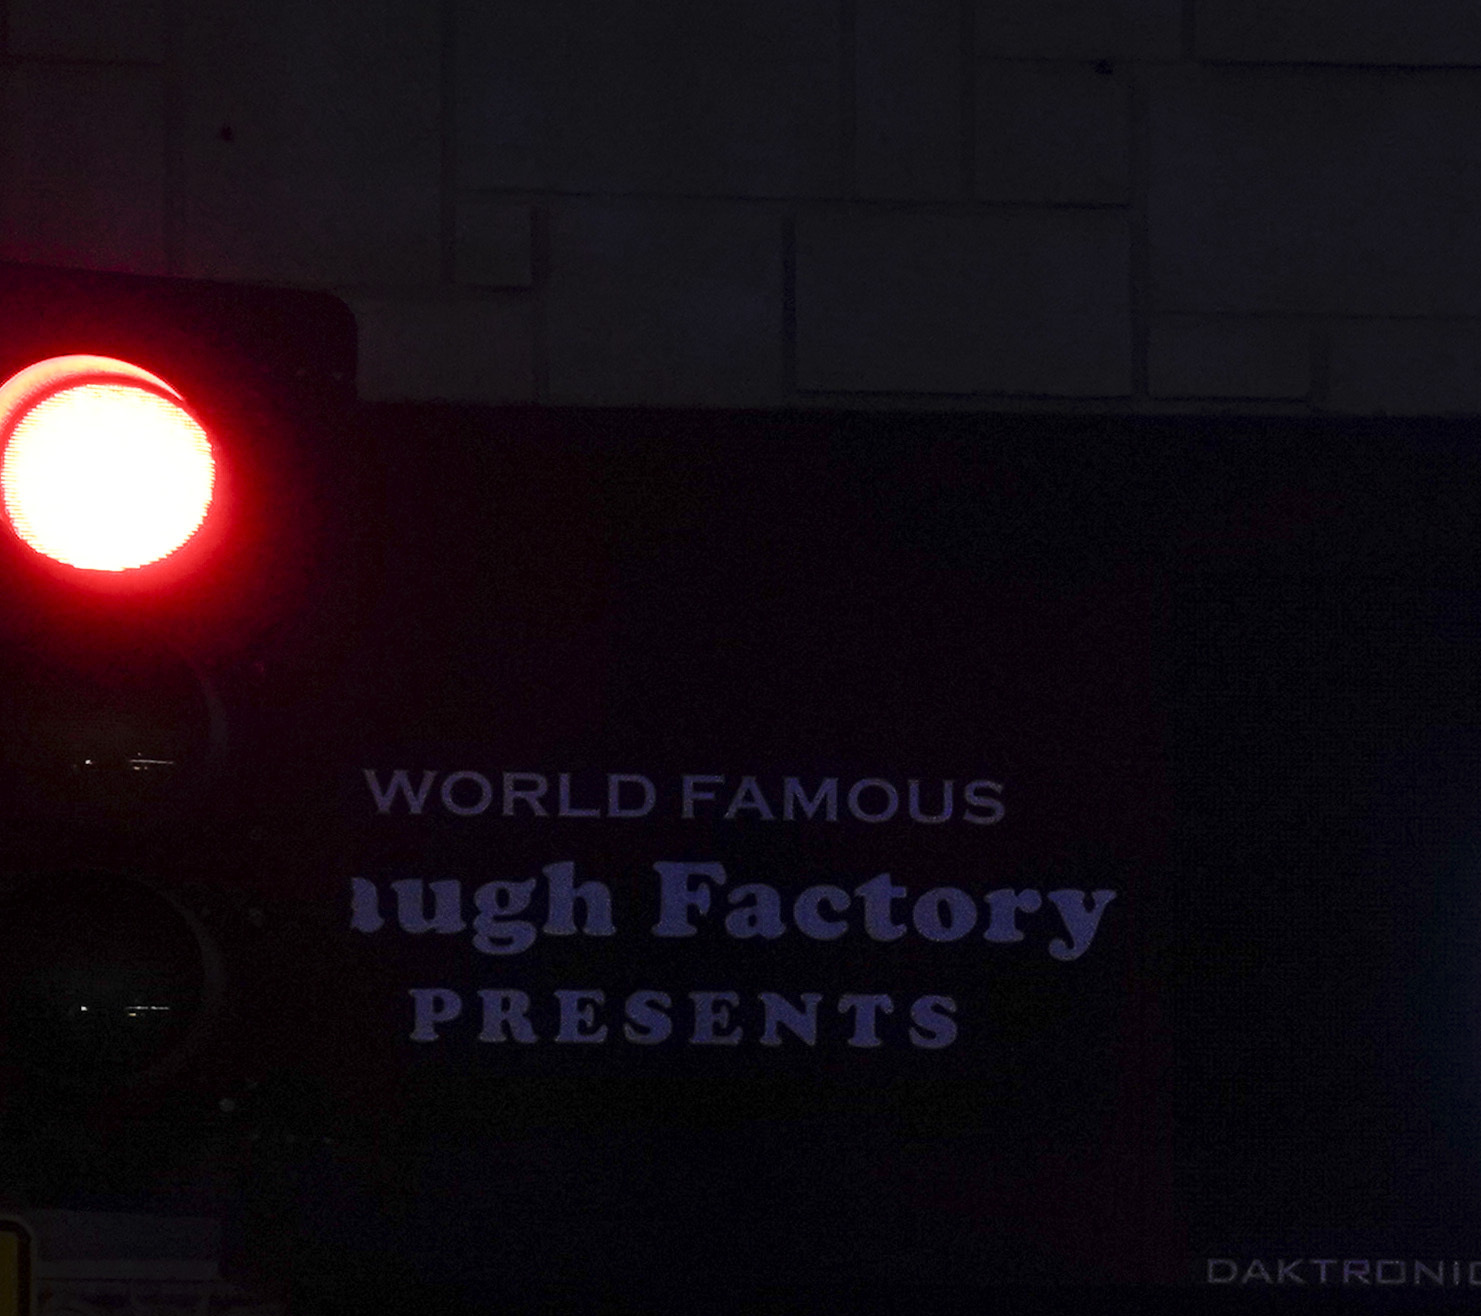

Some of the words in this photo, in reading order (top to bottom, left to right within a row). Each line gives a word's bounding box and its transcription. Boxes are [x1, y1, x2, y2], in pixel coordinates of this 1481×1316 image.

[363, 767, 657, 820] WORLD
[680, 773, 1006, 826] FAMOUS
[350, 860, 618, 957] ugh
[651, 859, 1118, 963] Factory
[408, 987, 960, 1050] PRESENTS
